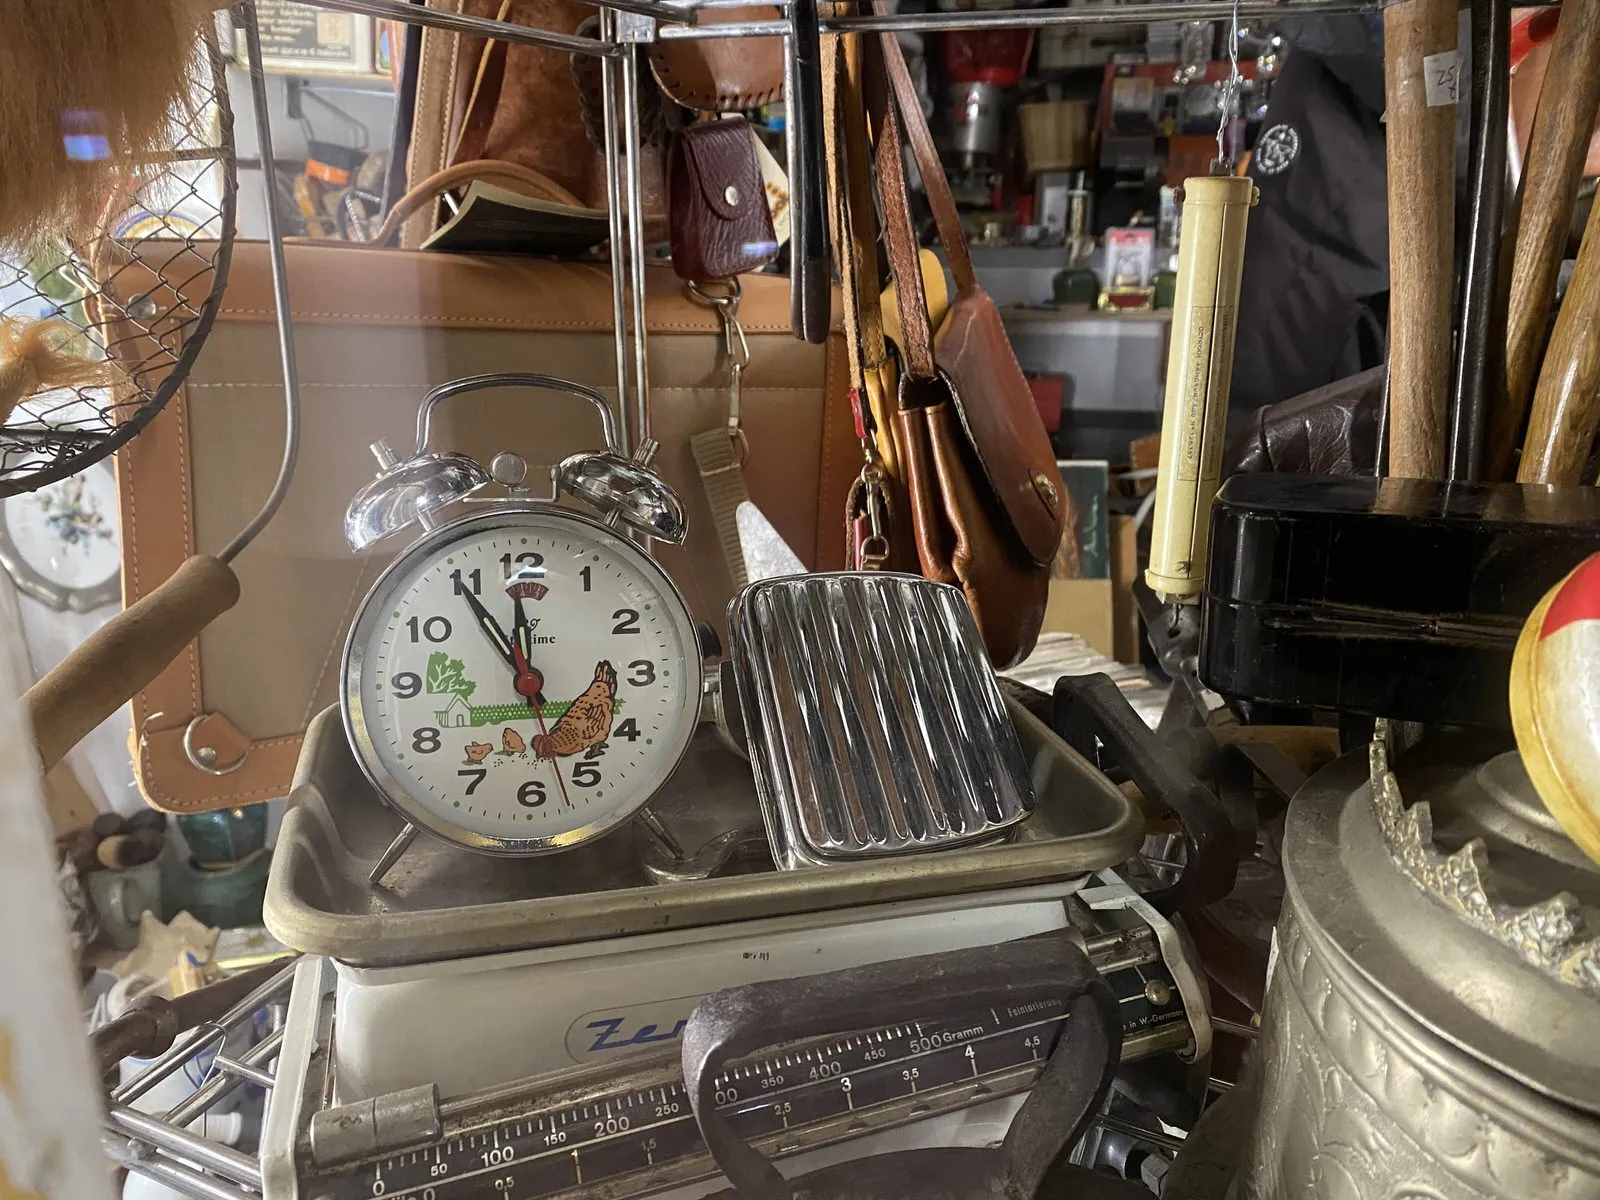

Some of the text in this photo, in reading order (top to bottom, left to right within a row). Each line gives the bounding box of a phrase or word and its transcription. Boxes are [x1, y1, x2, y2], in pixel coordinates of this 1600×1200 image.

[499, 552, 545, 580] 12
[579, 566, 592, 592] 1
[449, 568, 482, 596] 11
[405, 615, 452, 643] 10
[612, 608, 641, 635] 2
[391, 672, 422, 699] 9
[627, 660, 656, 687] 3
[412, 727, 441, 754] 8
[613, 718, 641, 742] 4
[457, 769, 487, 795] 7
[571, 762, 602, 788] 5
[517, 781, 547, 808] 6
[372, 1025, 984, 1196] 0 50 100 150 200 250 00 350 400 450 500 Gramm
[494, 1176, 515, 1191] 0,5
[774, 1102, 791, 1116] 2,5
[840, 1077, 852, 1092] 3
[902, 1067, 919, 1082] 3,5
[964, 1044, 975, 1059] 4
[1024, 1035, 1041, 1048] 4,5
